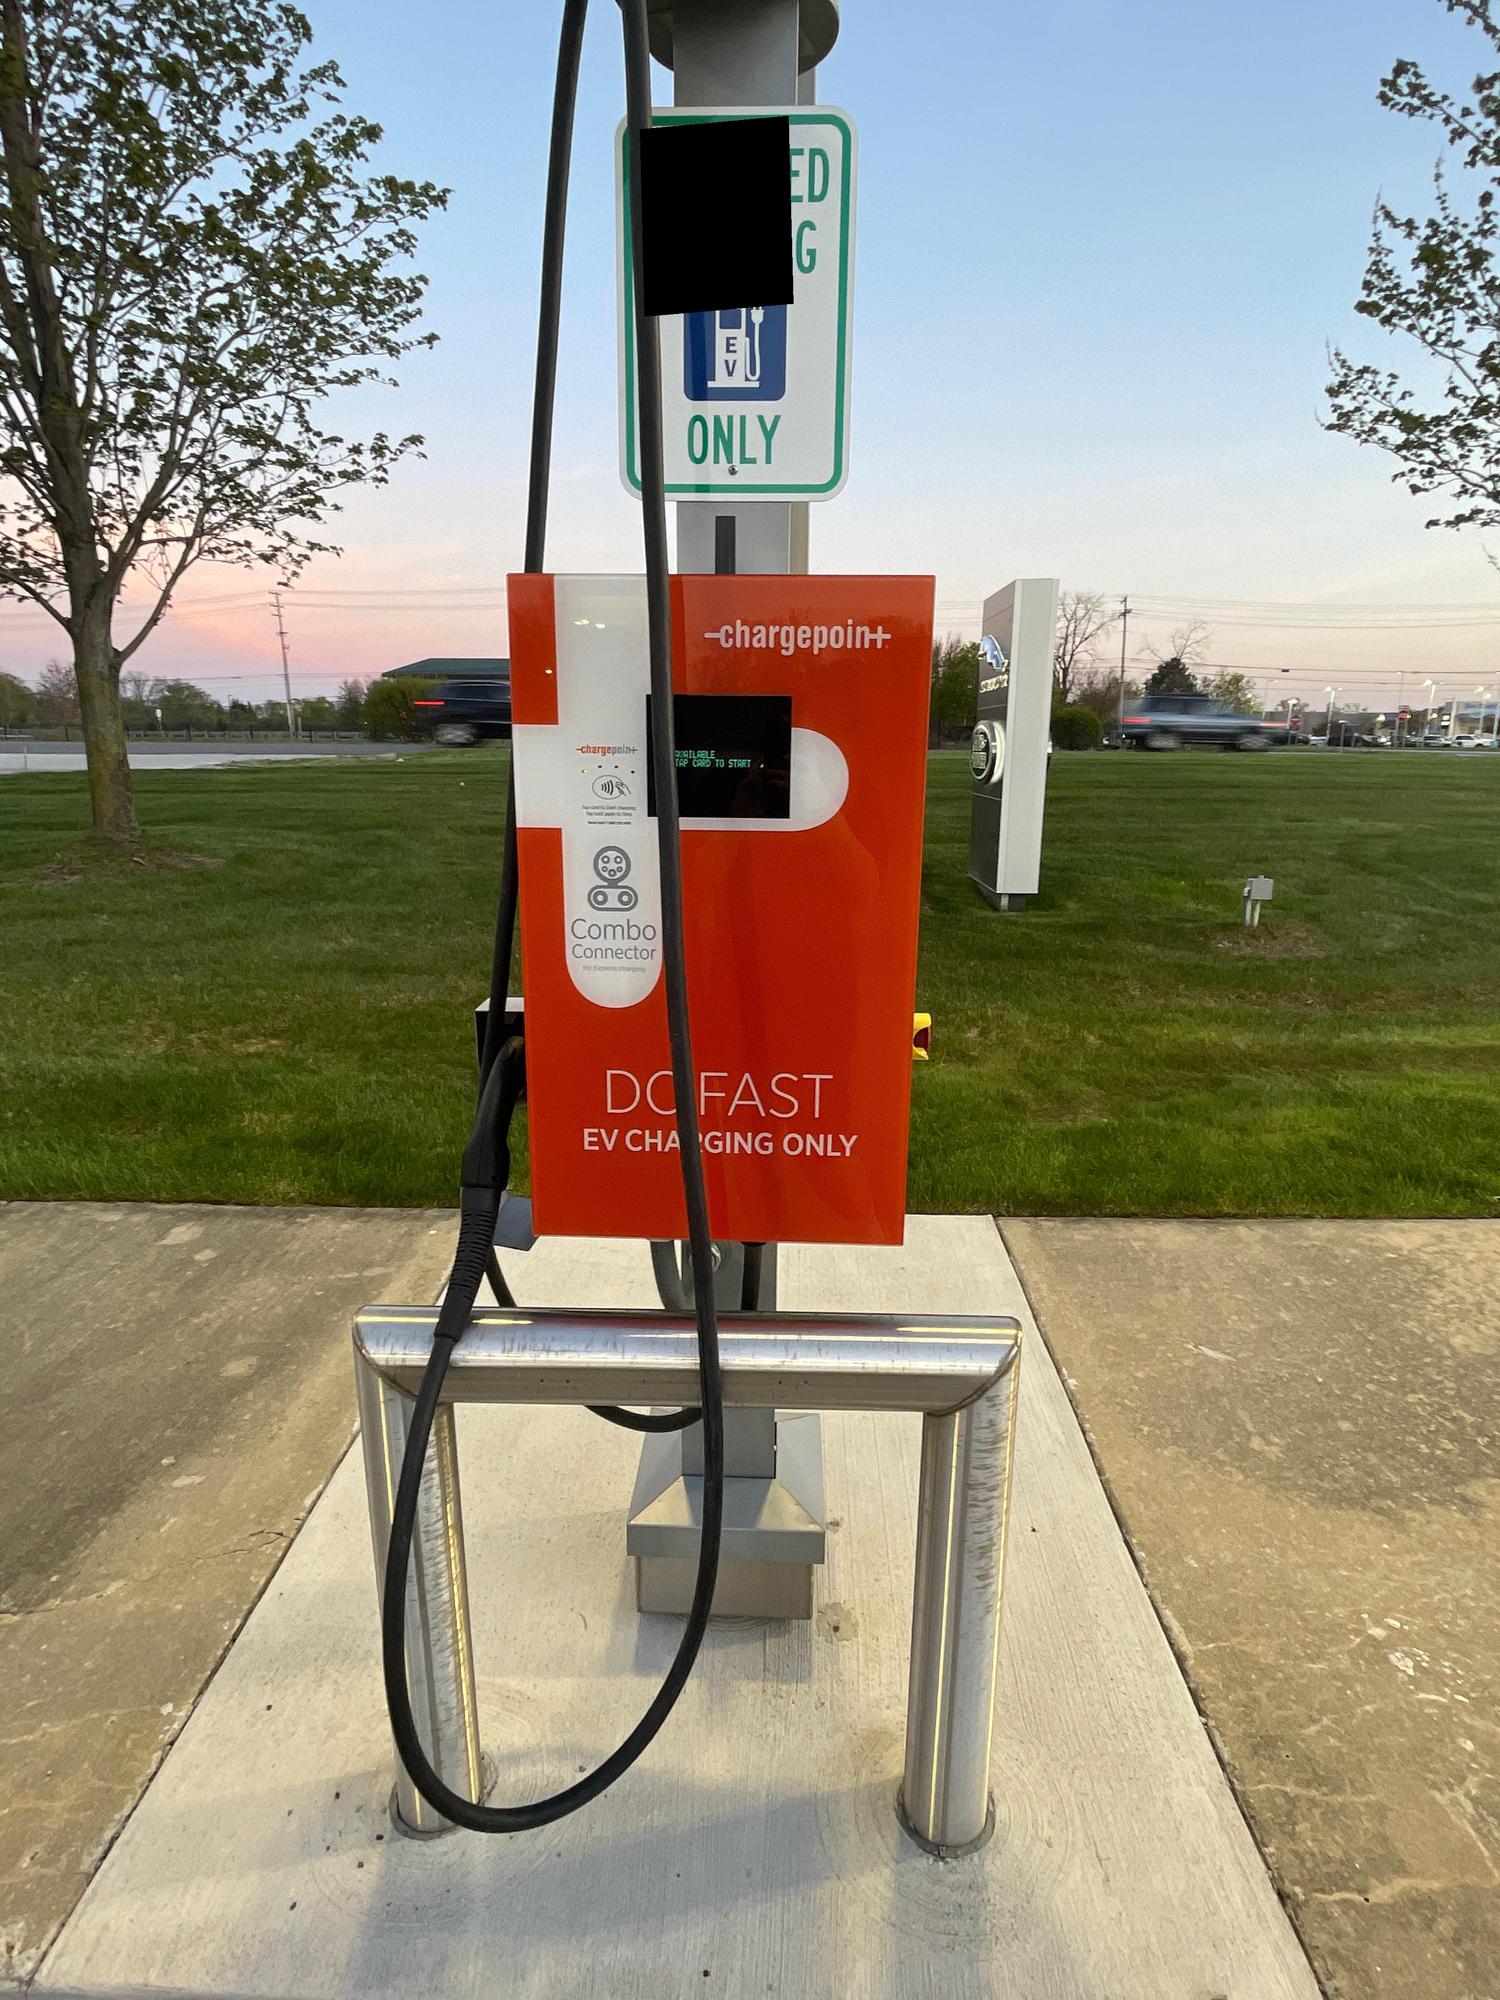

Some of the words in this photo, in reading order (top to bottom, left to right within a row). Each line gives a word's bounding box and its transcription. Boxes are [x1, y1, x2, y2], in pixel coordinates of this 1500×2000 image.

[687, 414, 782, 465] ONLY
[692, 759, 712, 768] CARD
[715, 759, 725, 768] TO
[728, 759, 752, 768] START
[571, 918, 657, 941] Combo
[571, 943, 657, 960] Connector
[700, 1072, 834, 1118] FAST
[582, 1128, 619, 1151] EV
[624, 1128, 773, 1155] CHAGING
[782, 1132, 859, 1157] ONLY
